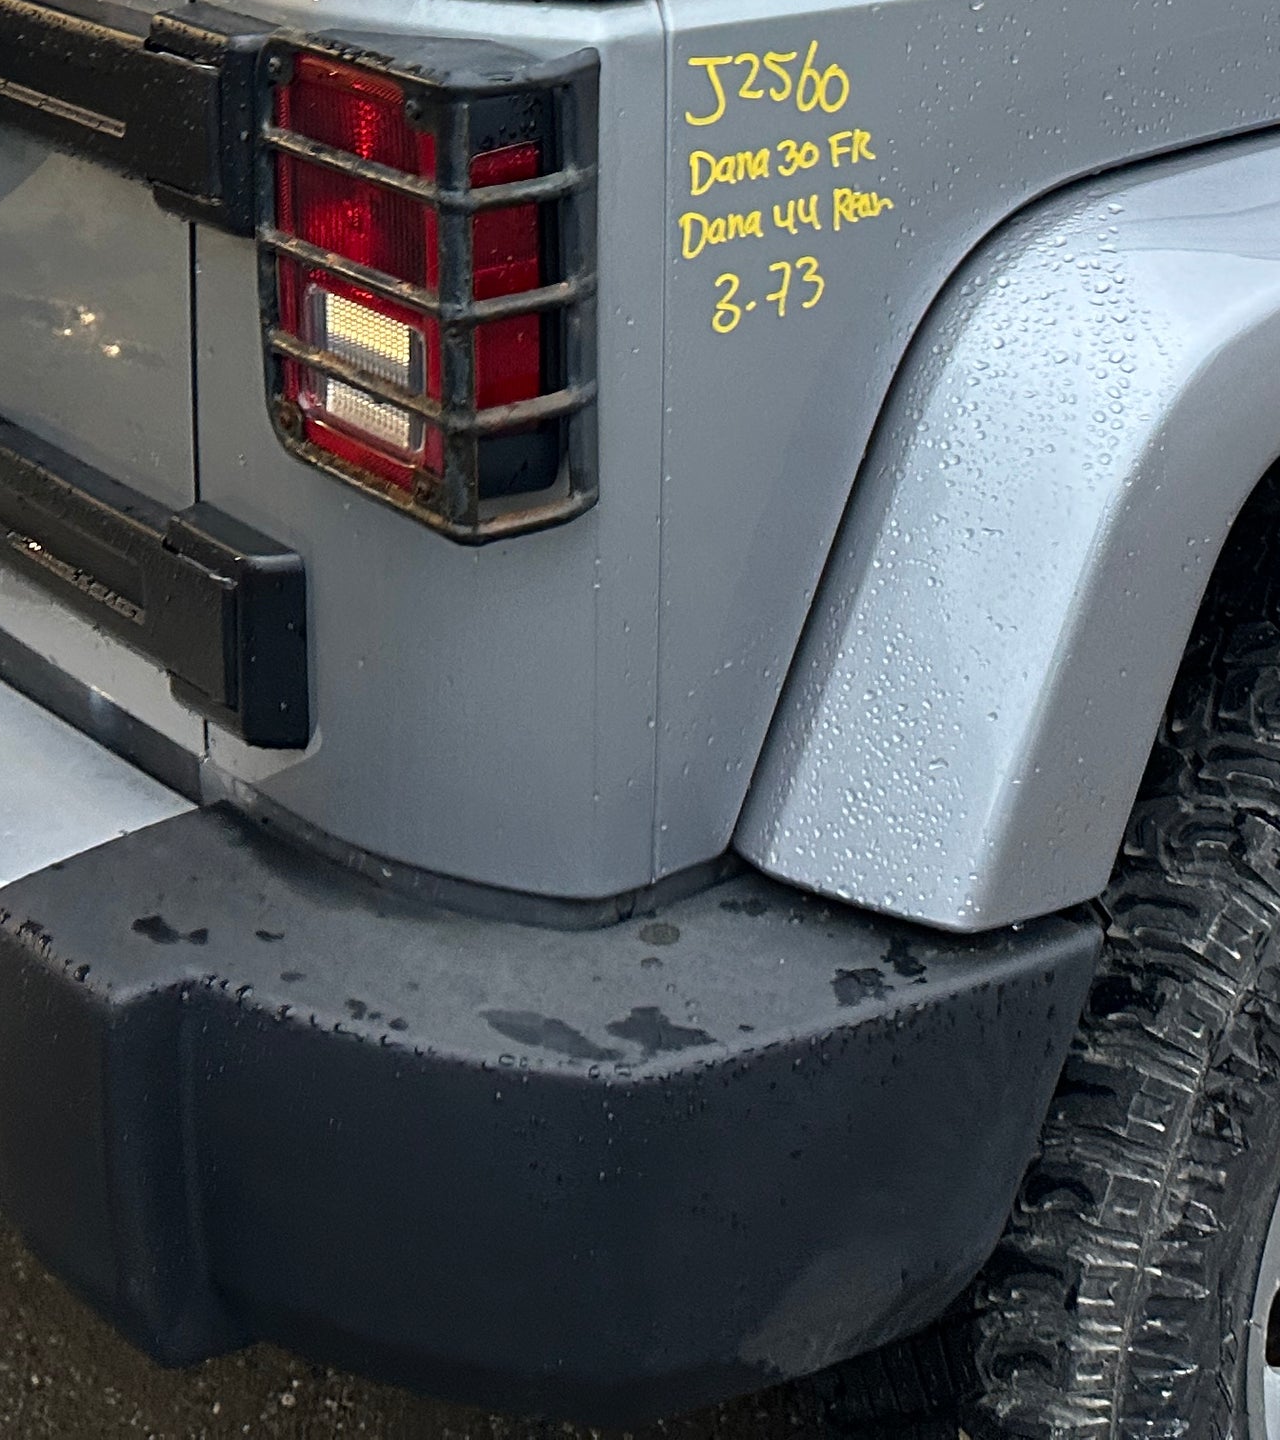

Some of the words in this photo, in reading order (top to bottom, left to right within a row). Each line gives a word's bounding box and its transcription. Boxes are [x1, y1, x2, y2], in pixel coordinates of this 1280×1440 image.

[685, 40, 850, 126] J2560
[689, 150, 770, 195] Dana
[777, 140, 820, 177] 30
[828, 129, 876, 167] FR
[679, 212, 764, 259] Dana
[773, 194, 822, 234] 44
